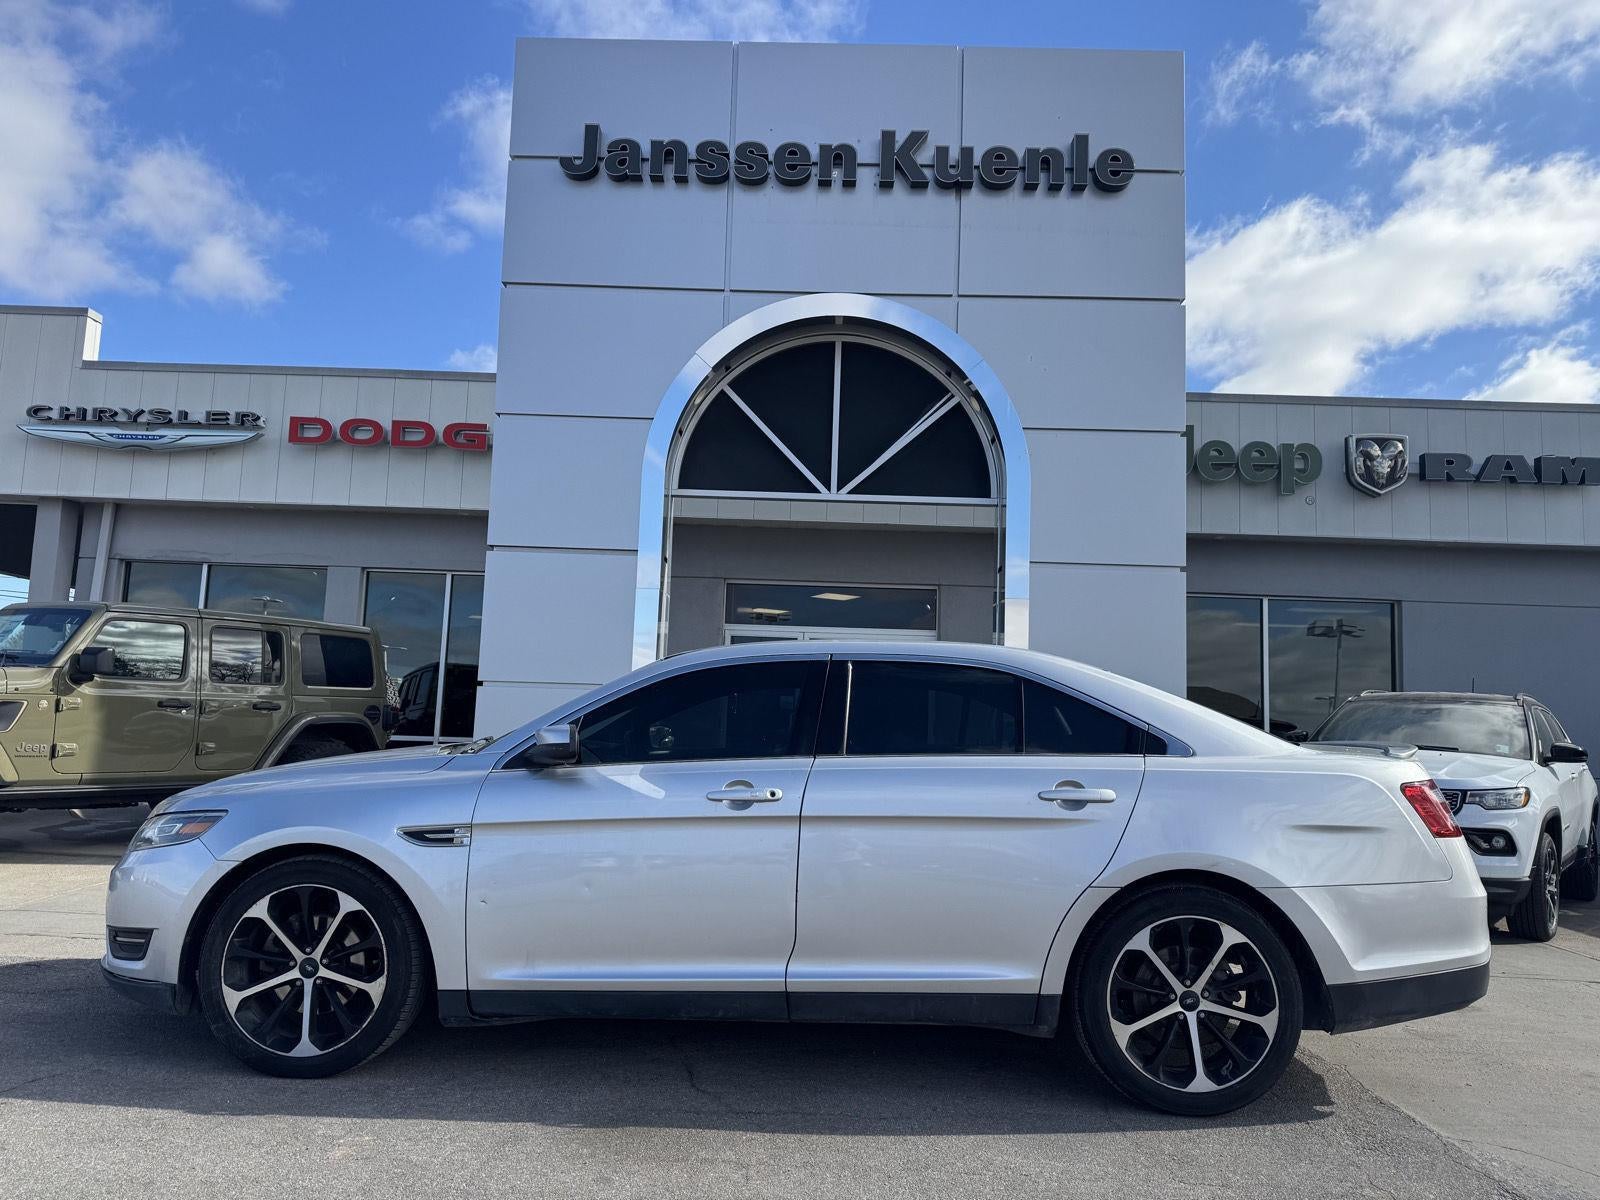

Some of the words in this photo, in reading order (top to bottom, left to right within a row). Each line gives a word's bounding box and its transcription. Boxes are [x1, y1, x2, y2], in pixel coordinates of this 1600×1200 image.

[558, 123, 858, 187] Janssen
[879, 129, 1136, 192] Kuenle
[26, 404, 263, 427] CHRYSLER
[1419, 452, 1600, 487] RAM
[15, 741, 49, 754] Jeep
